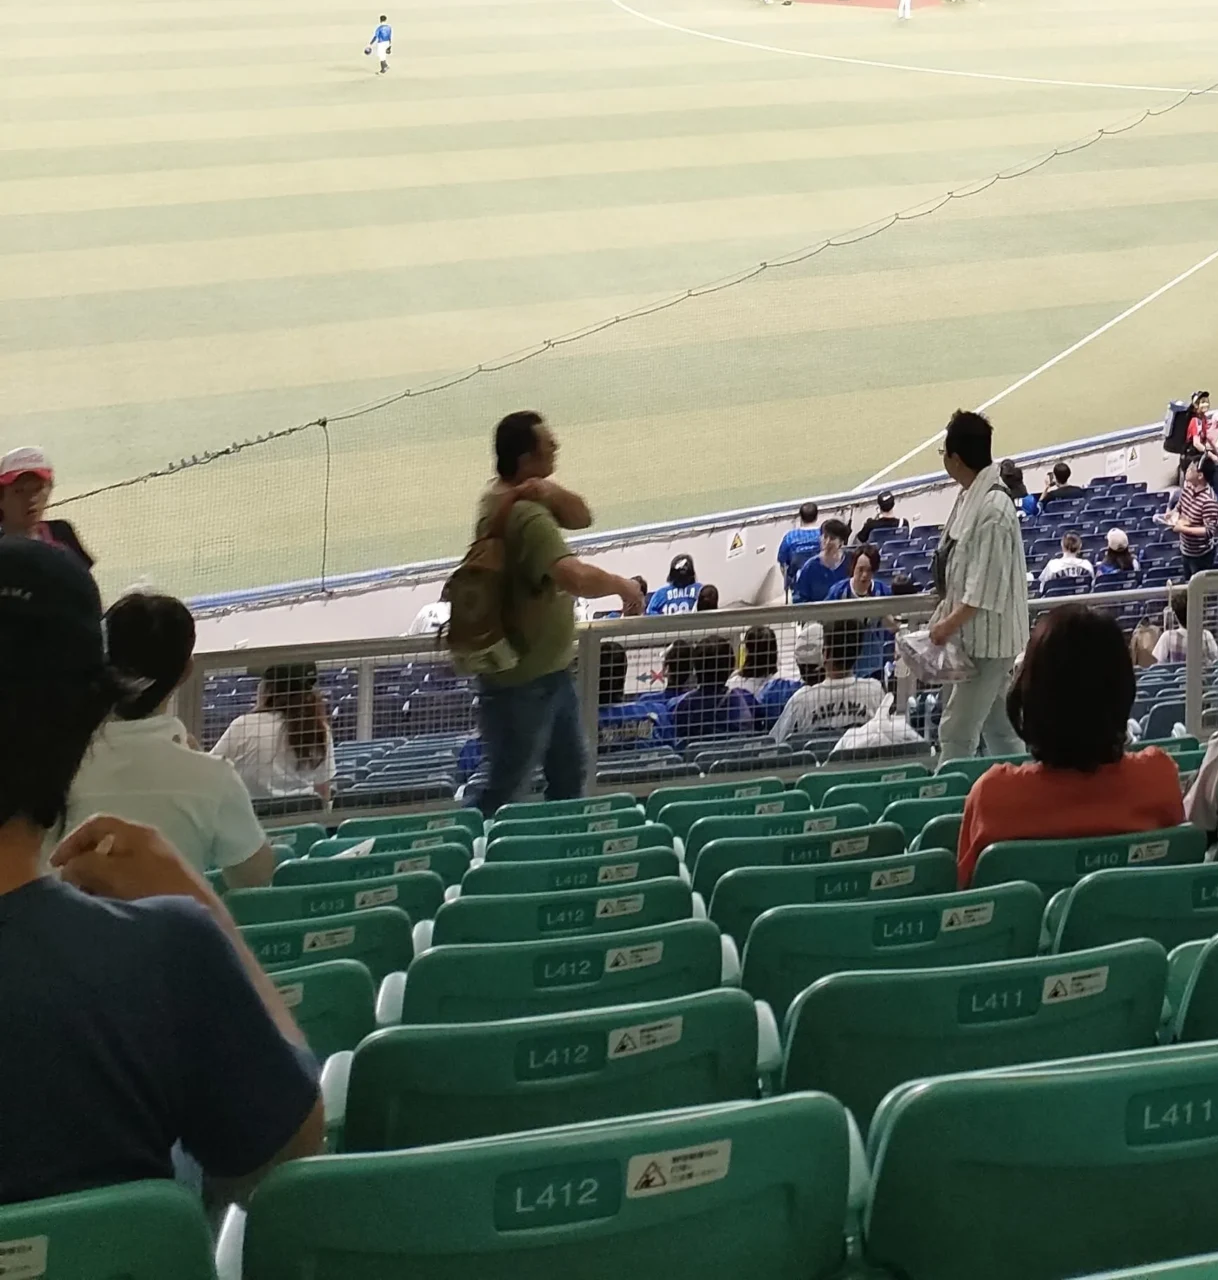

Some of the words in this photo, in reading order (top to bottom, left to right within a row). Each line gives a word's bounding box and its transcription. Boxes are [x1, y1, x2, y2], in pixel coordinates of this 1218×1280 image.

[1084, 852, 1119, 867] L410
[556, 874, 588, 886] L412
[824, 879, 859, 896] L411
[310, 898, 345, 912] L413
[547, 909, 585, 925] L412
[883, 918, 924, 937] L411
[544, 960, 592, 977] L412
[971, 989, 1023, 1011] L411
[529, 1045, 590, 1070] L412
[1144, 1099, 1212, 1130] L411
[517, 1179, 598, 1214] L412
